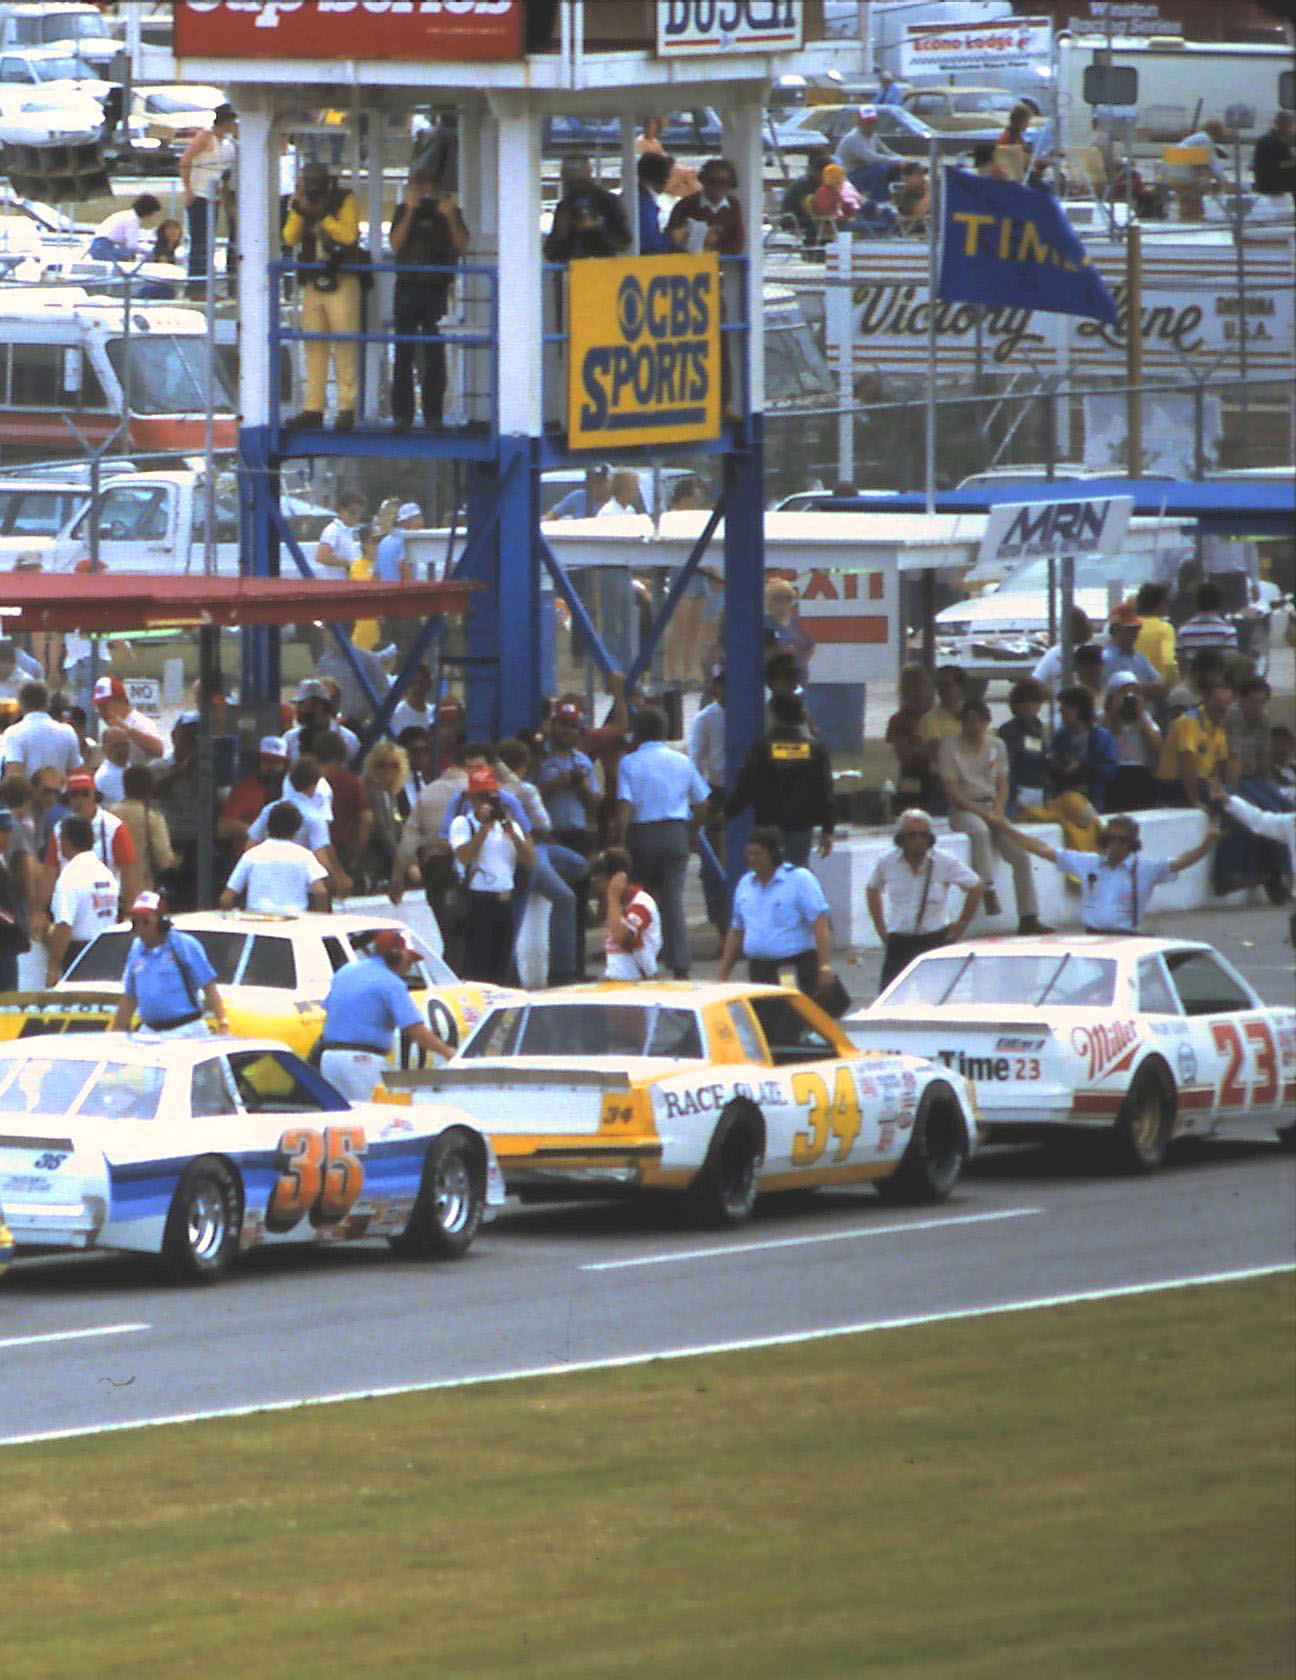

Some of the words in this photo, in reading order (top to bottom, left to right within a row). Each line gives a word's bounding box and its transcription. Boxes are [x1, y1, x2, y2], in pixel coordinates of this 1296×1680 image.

[647, 272, 711, 338] CBS
[581, 340, 709, 432] SPORTS
[1001, 501, 1111, 545] MRN
[940, 1050, 1009, 1081] Time
[1015, 1058, 1041, 1080] 23
[1072, 1020, 1137, 1081] Miller
[1210, 1021, 1277, 1109] 23
[604, 1105, 633, 1125] 34
[664, 1083, 724, 1118] RACE
[791, 1066, 862, 1165] 34
